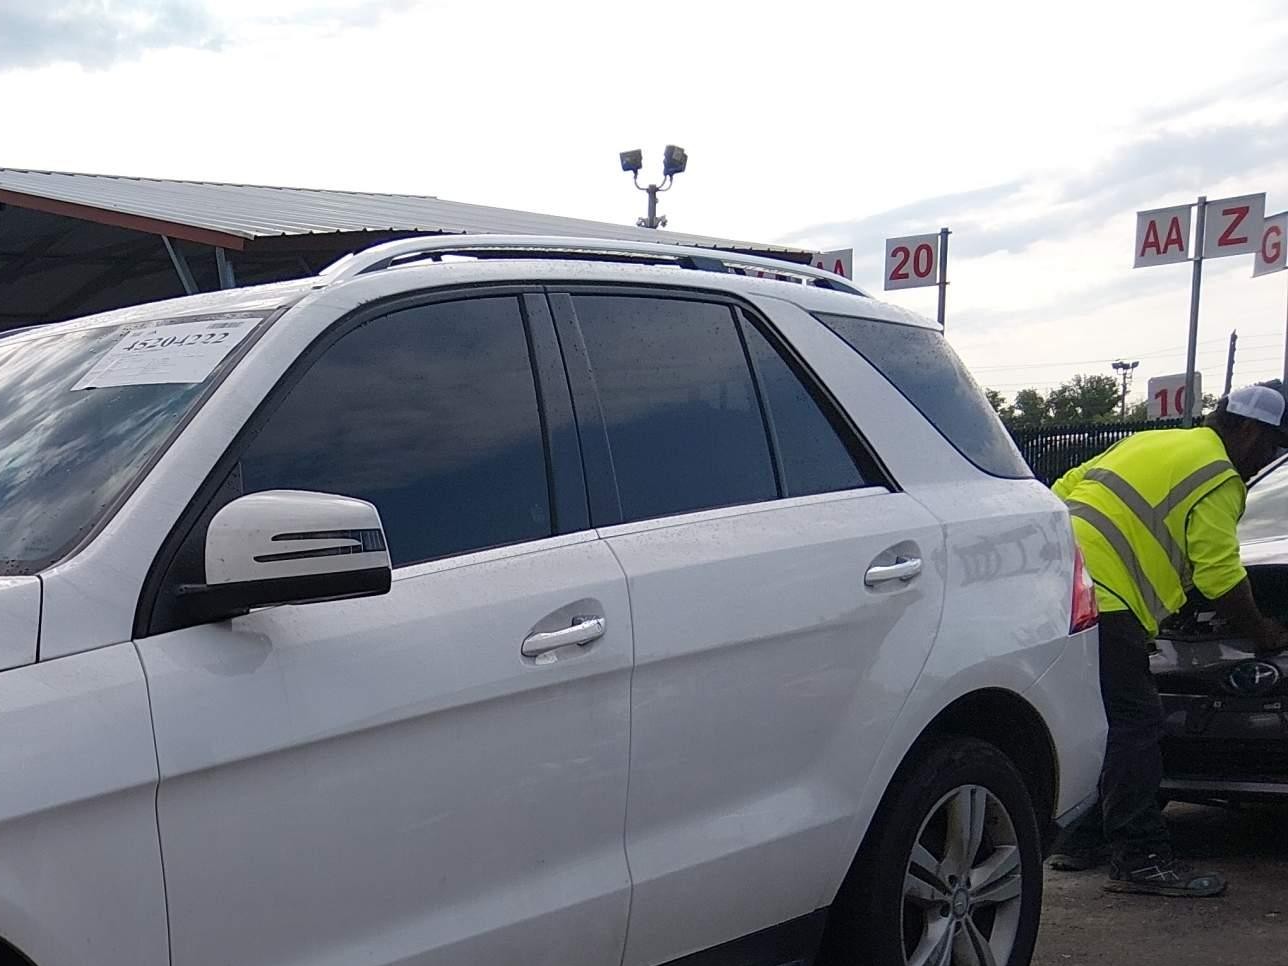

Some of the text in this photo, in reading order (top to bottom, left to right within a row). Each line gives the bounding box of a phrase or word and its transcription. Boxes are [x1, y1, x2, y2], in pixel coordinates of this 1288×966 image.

[1140, 216, 1184, 257] AA
[1217, 206, 1250, 247] Z
[1262, 225, 1282, 264] G
[888, 243, 934, 280] 20
